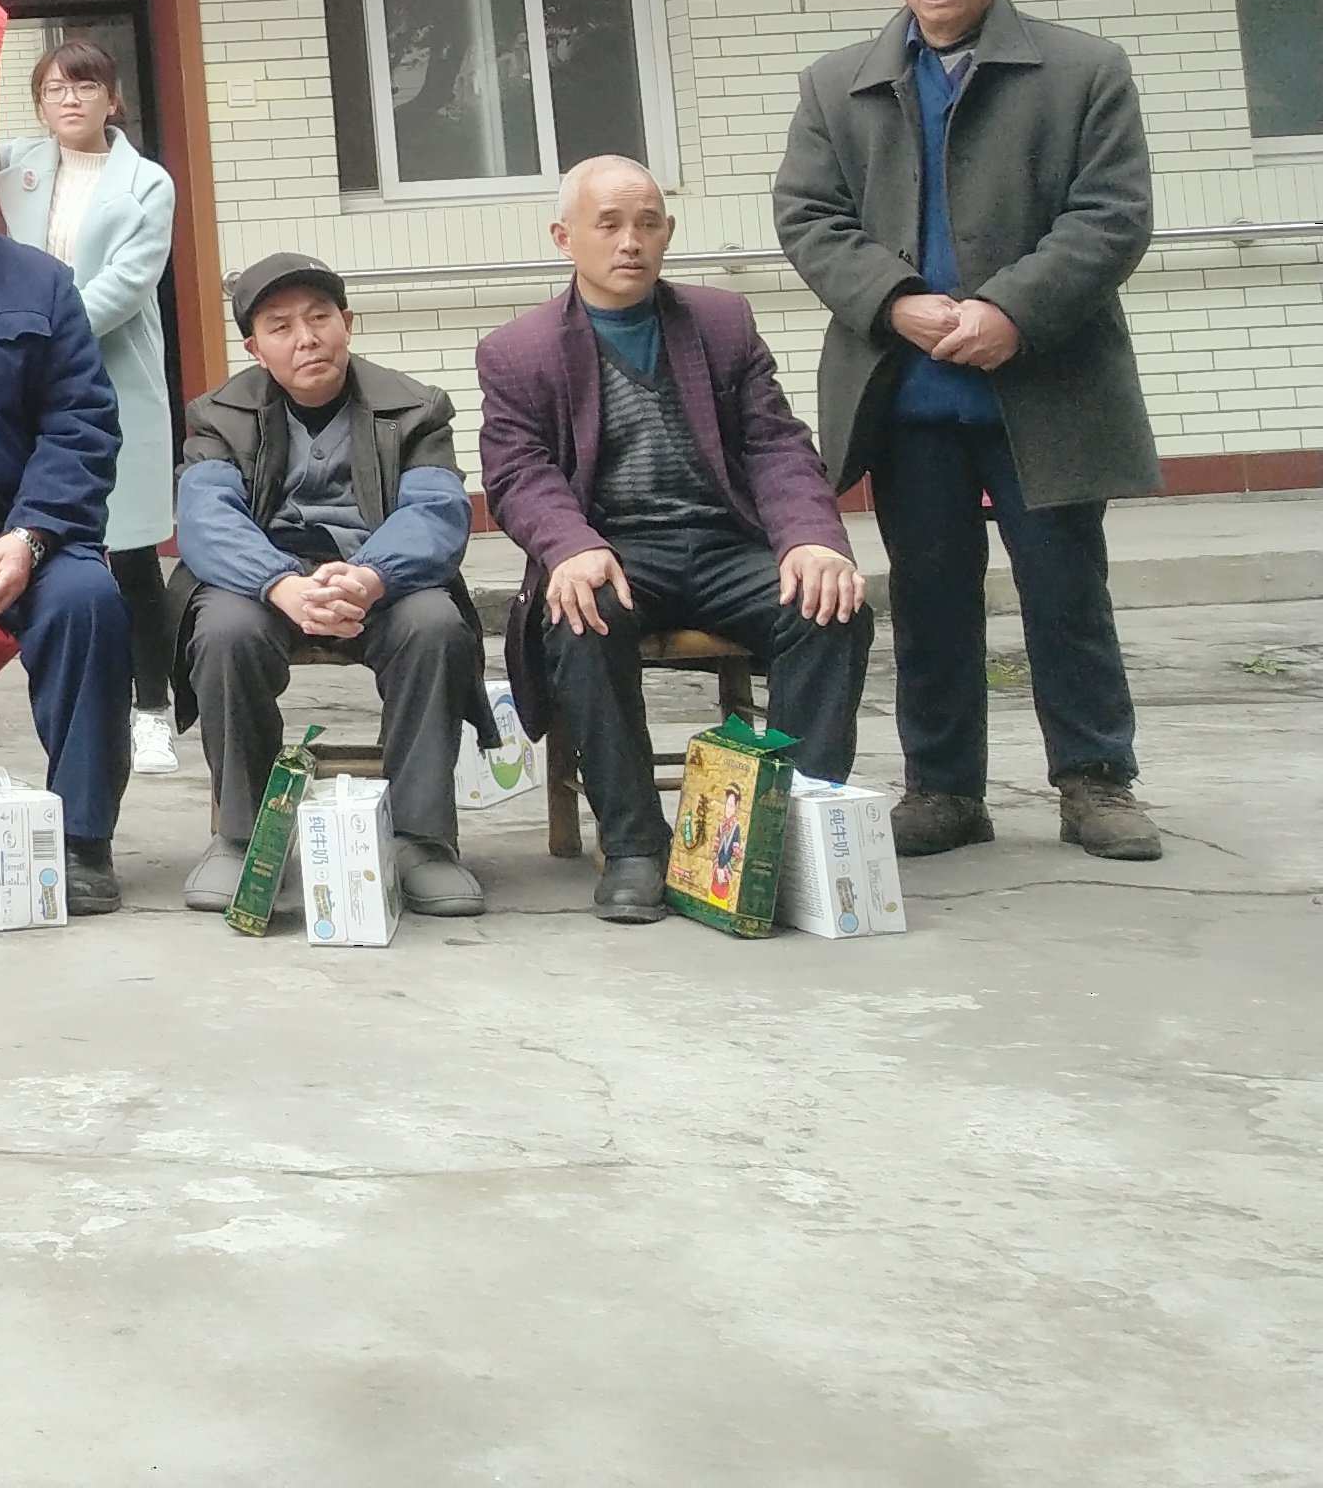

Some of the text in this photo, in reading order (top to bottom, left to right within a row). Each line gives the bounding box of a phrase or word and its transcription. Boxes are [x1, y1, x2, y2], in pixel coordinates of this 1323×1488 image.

[308, 815, 329, 865] 纯牛奶
[829, 808, 850, 858] 纯牛奶
